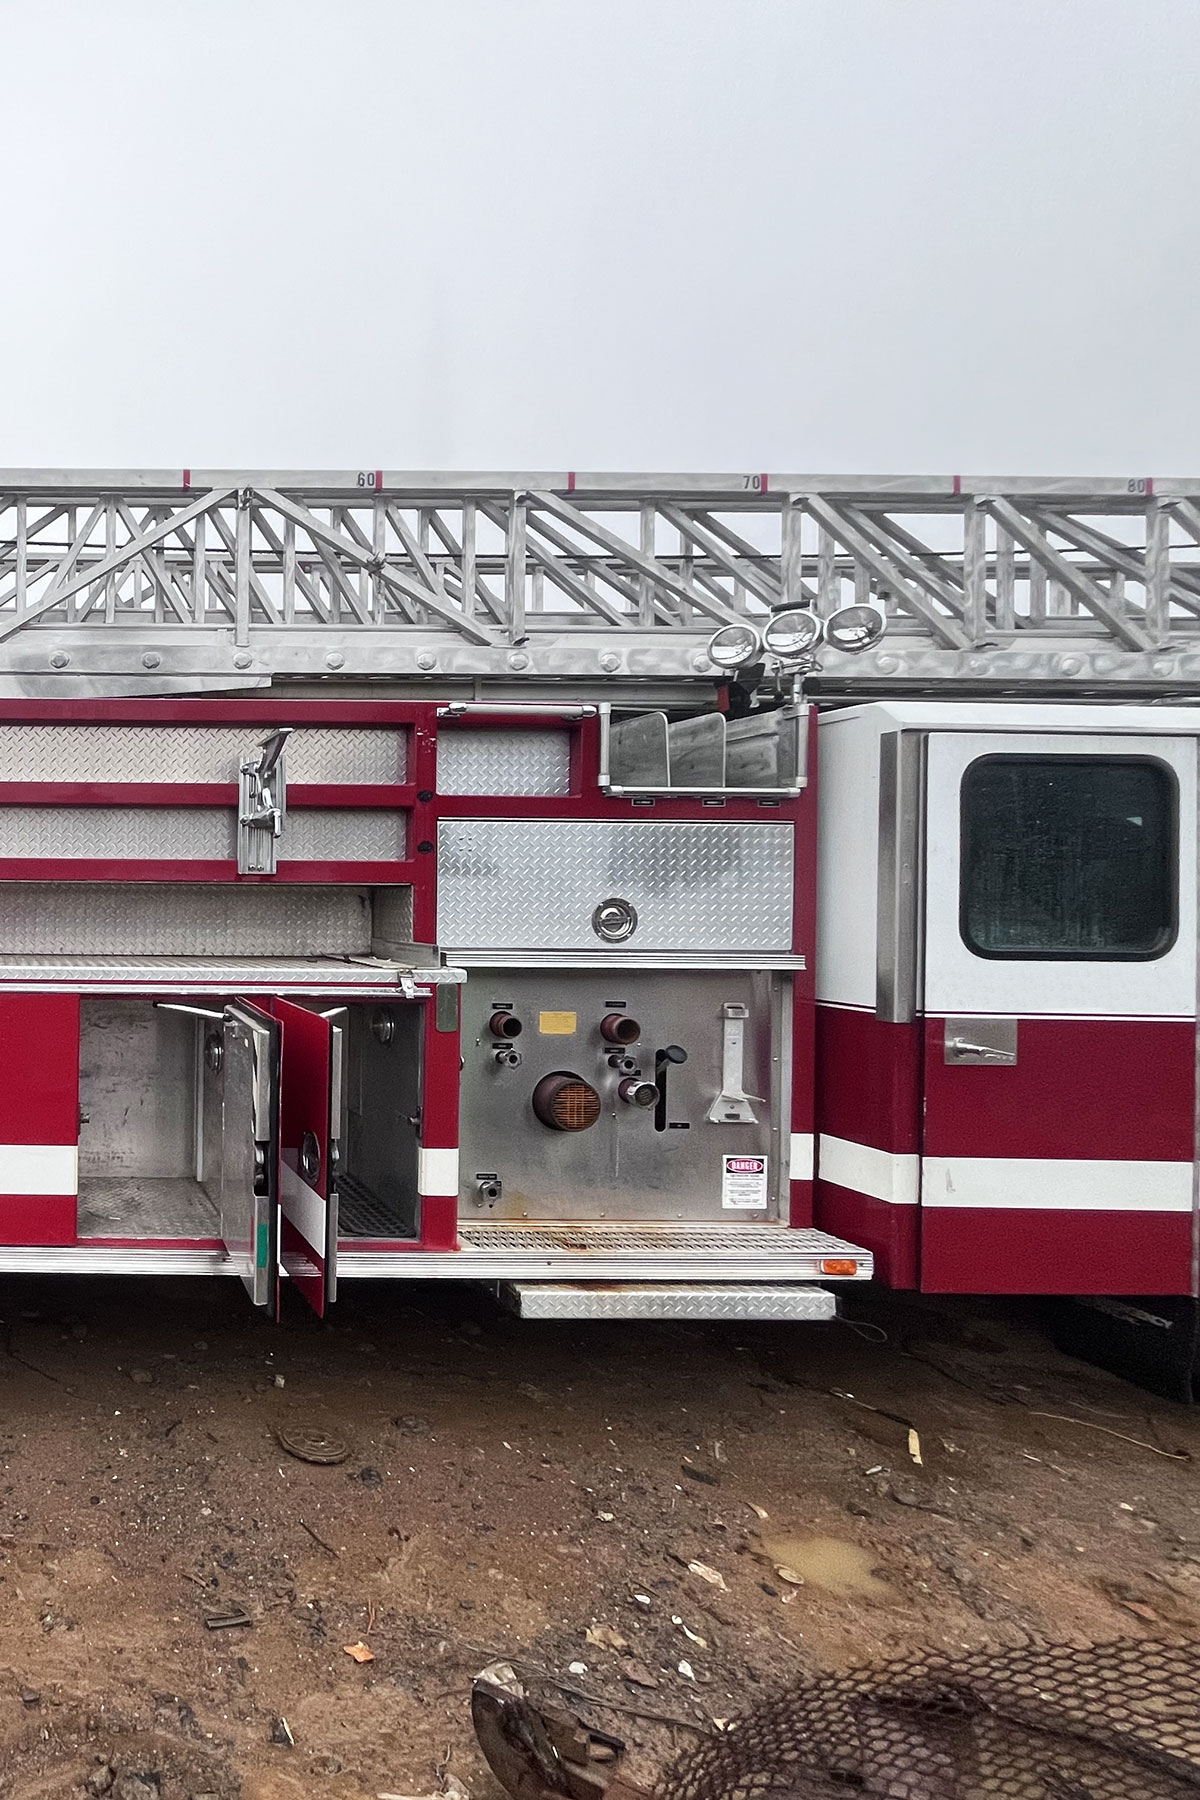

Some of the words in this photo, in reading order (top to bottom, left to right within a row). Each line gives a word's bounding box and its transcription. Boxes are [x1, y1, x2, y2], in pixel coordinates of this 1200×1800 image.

[357, 471, 375, 487] 60
[743, 475, 760, 490] 70
[1127, 478, 1145, 493] 80
[731, 1161, 758, 1170] DANGER
